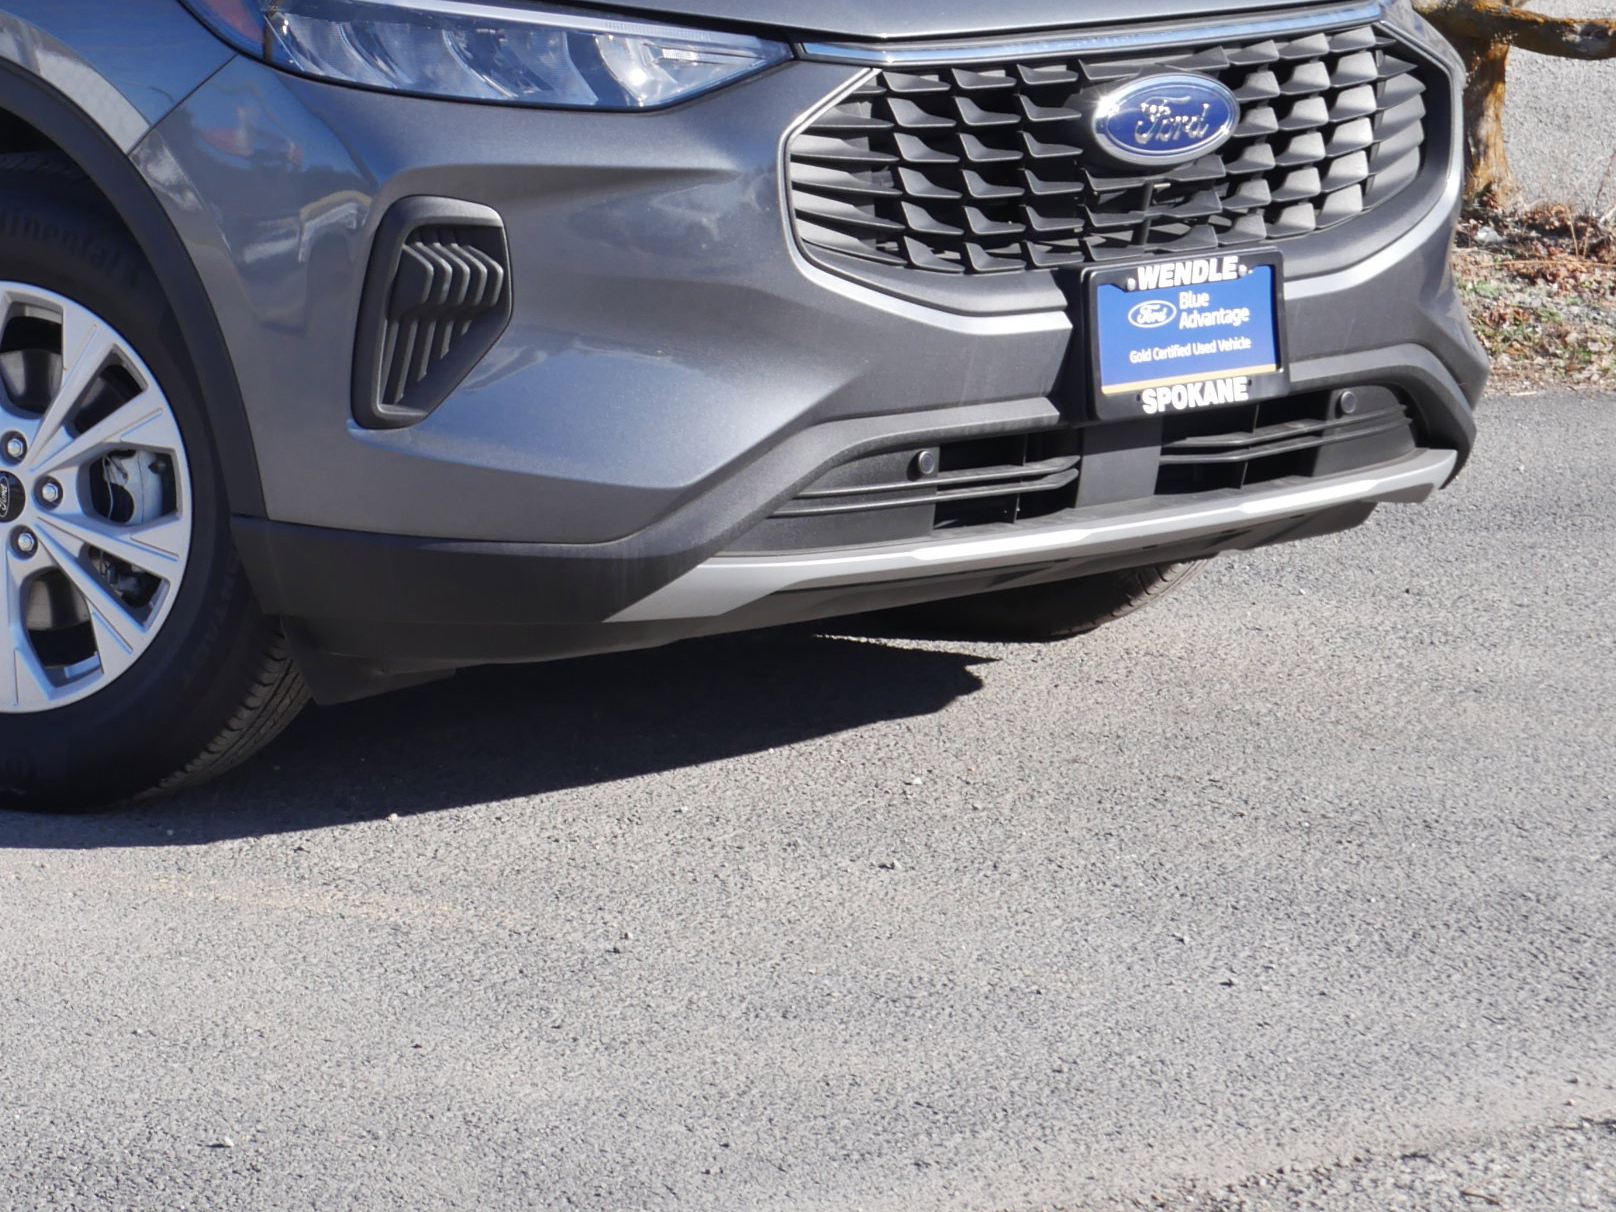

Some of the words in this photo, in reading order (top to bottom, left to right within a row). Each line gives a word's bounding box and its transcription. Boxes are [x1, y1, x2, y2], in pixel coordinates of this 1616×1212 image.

[1134, 95, 1210, 145] Ford
[1136, 255, 1239, 290] WENDLE
[1179, 290, 1210, 310] Blue
[1136, 304, 1168, 325] Ford
[1179, 307, 1250, 329] Advantage
[1129, 348, 1152, 364] Gold
[1153, 343, 1191, 361] Certified
[1192, 340, 1217, 355] Used
[1218, 336, 1252, 353] Vehicle
[1142, 376, 1249, 415] SPOKANE
